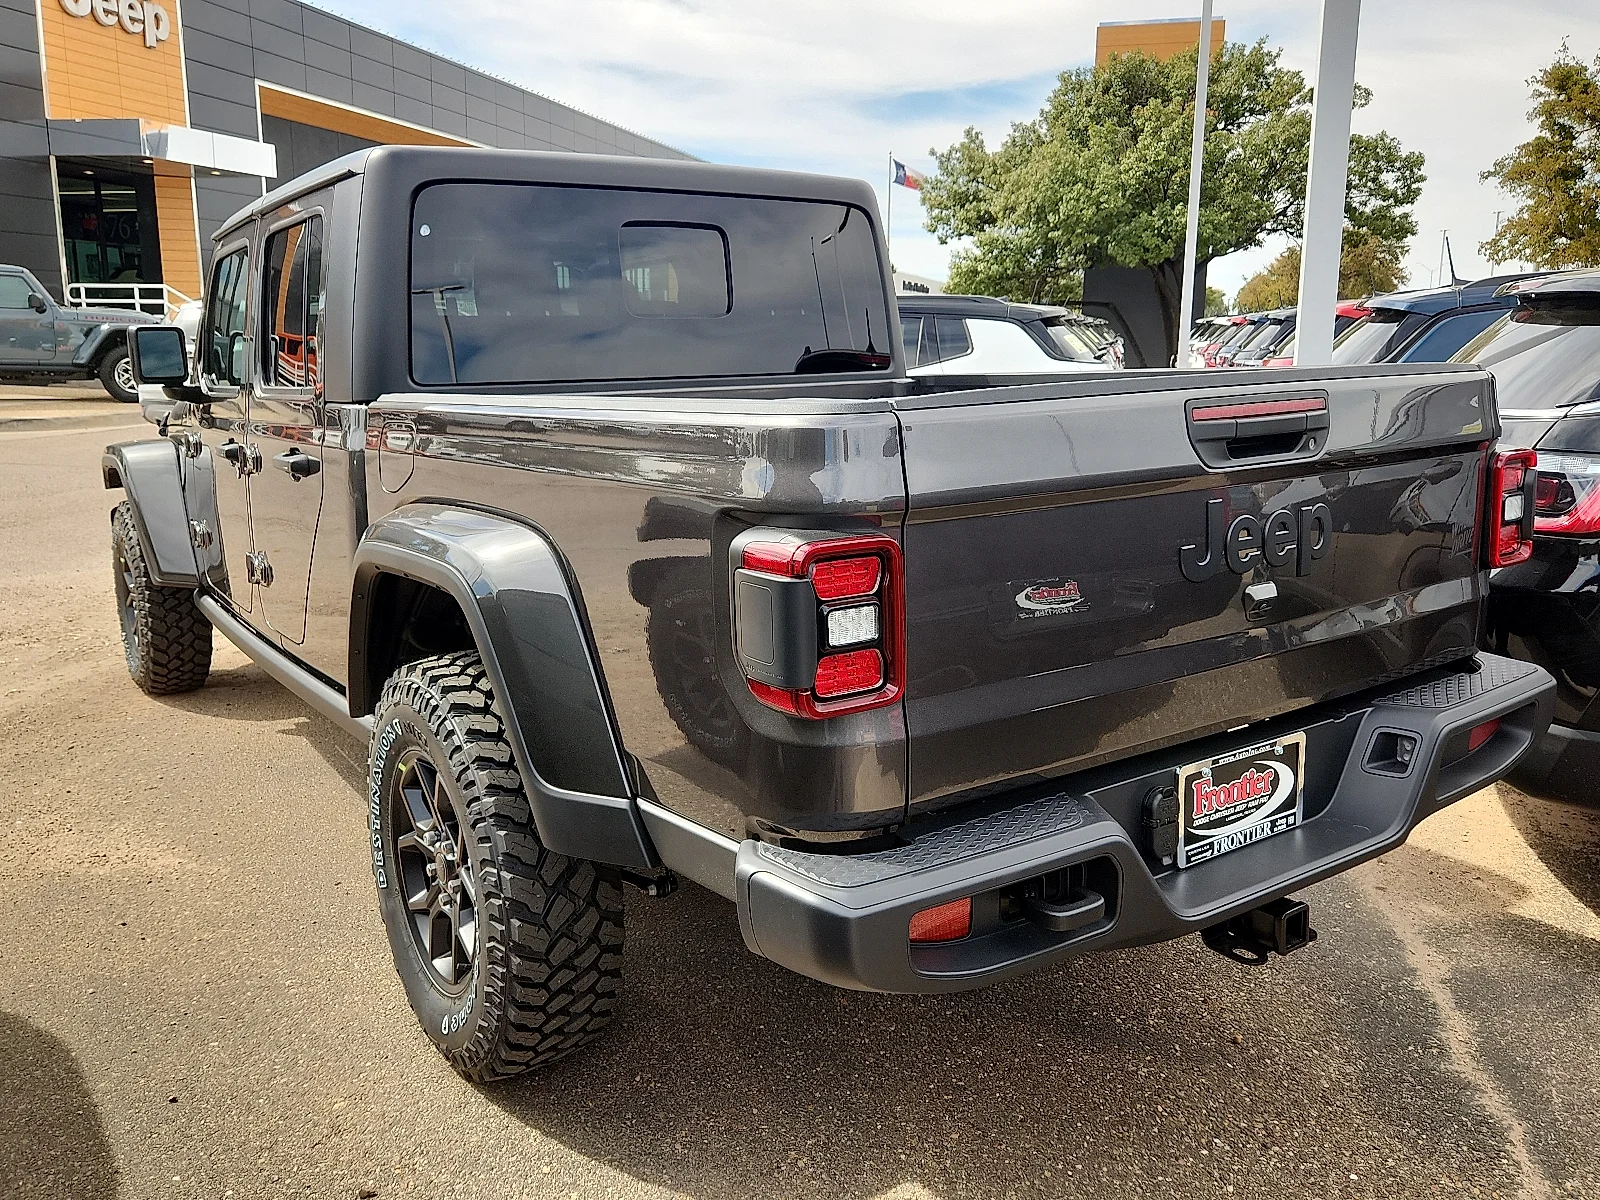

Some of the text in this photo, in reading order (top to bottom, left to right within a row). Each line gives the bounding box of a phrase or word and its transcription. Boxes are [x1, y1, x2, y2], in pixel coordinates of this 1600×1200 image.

[1179, 498, 1333, 584] Jeep
[370, 722, 396, 889] DESTINATION
[1192, 768, 1275, 819] Frontier
[1193, 815, 1210, 828] DODGE
[1213, 821, 1272, 856] FRONTIER
